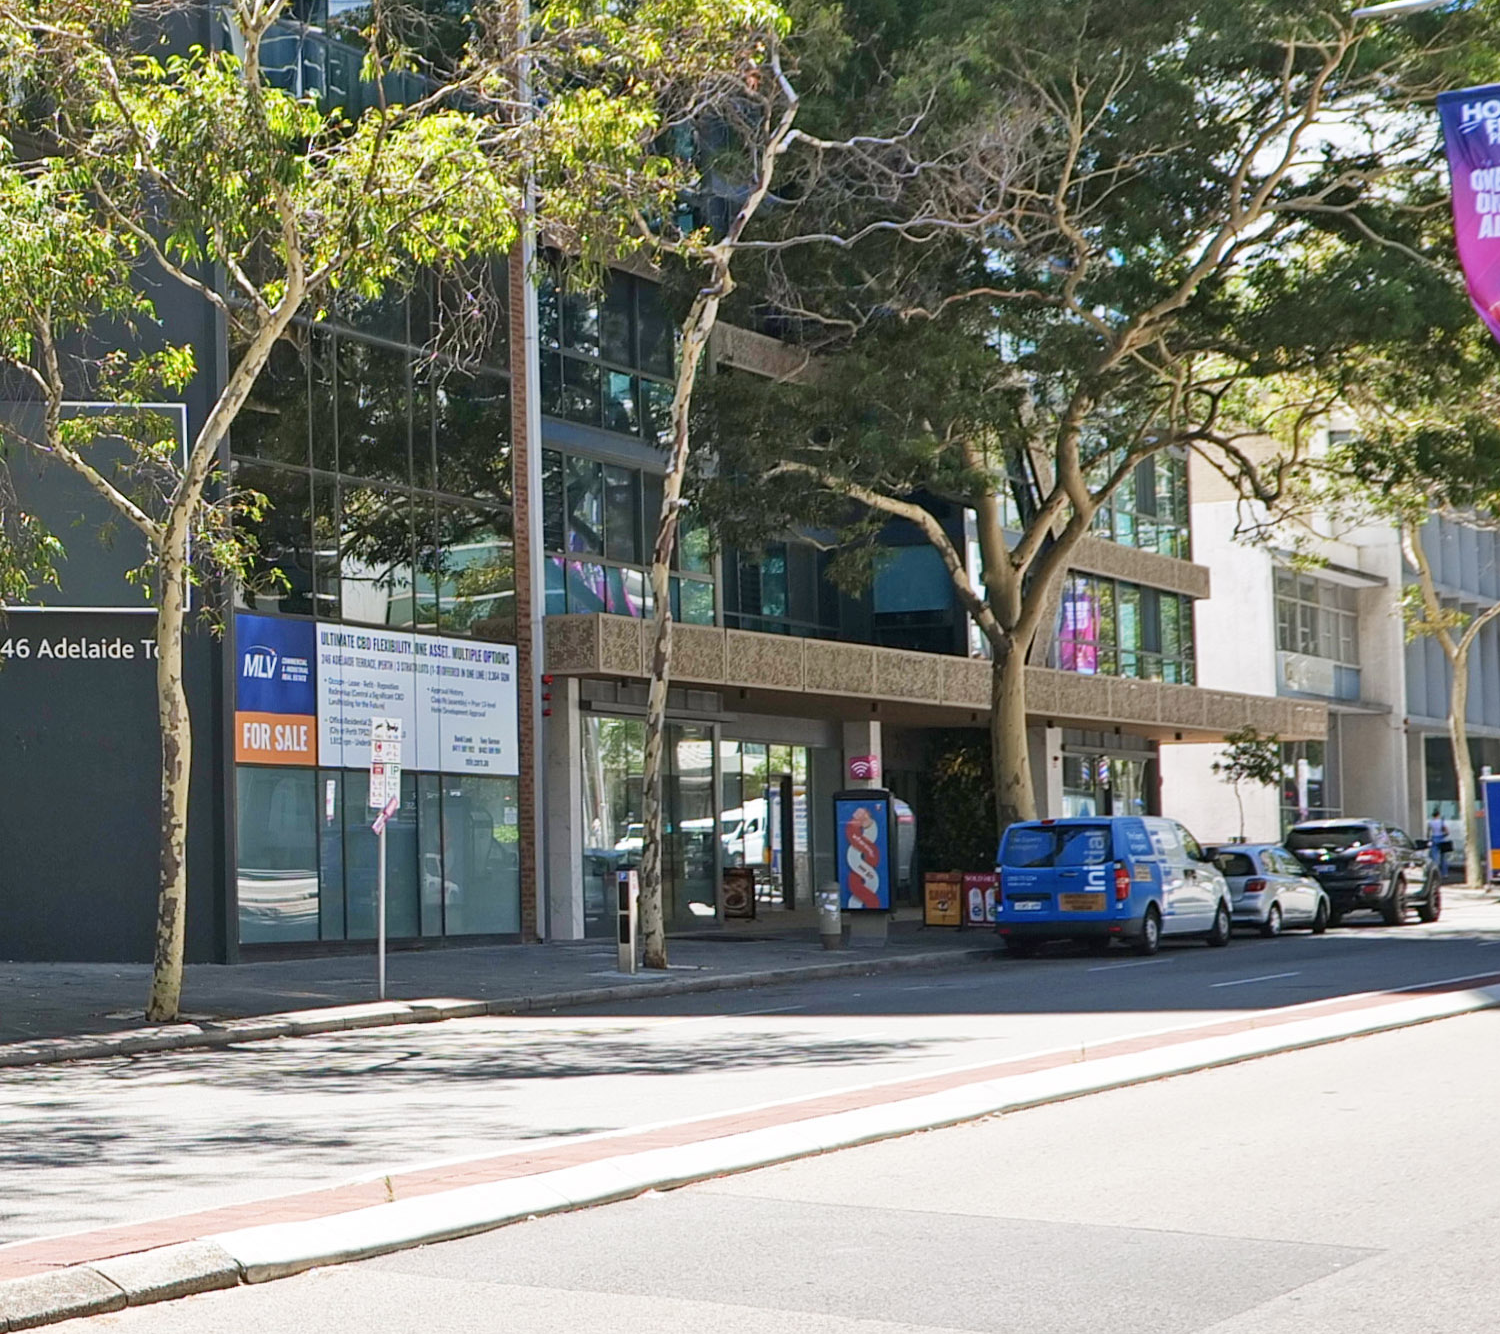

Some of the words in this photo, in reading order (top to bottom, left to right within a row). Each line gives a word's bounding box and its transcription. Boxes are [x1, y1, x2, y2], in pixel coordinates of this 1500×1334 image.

[37, 637, 135, 659] Adelaide
[243, 653, 278, 679] MLV
[243, 723, 272, 751] FOR
[275, 724, 309, 752] SALE
[1082, 830, 1107, 892] Initial
